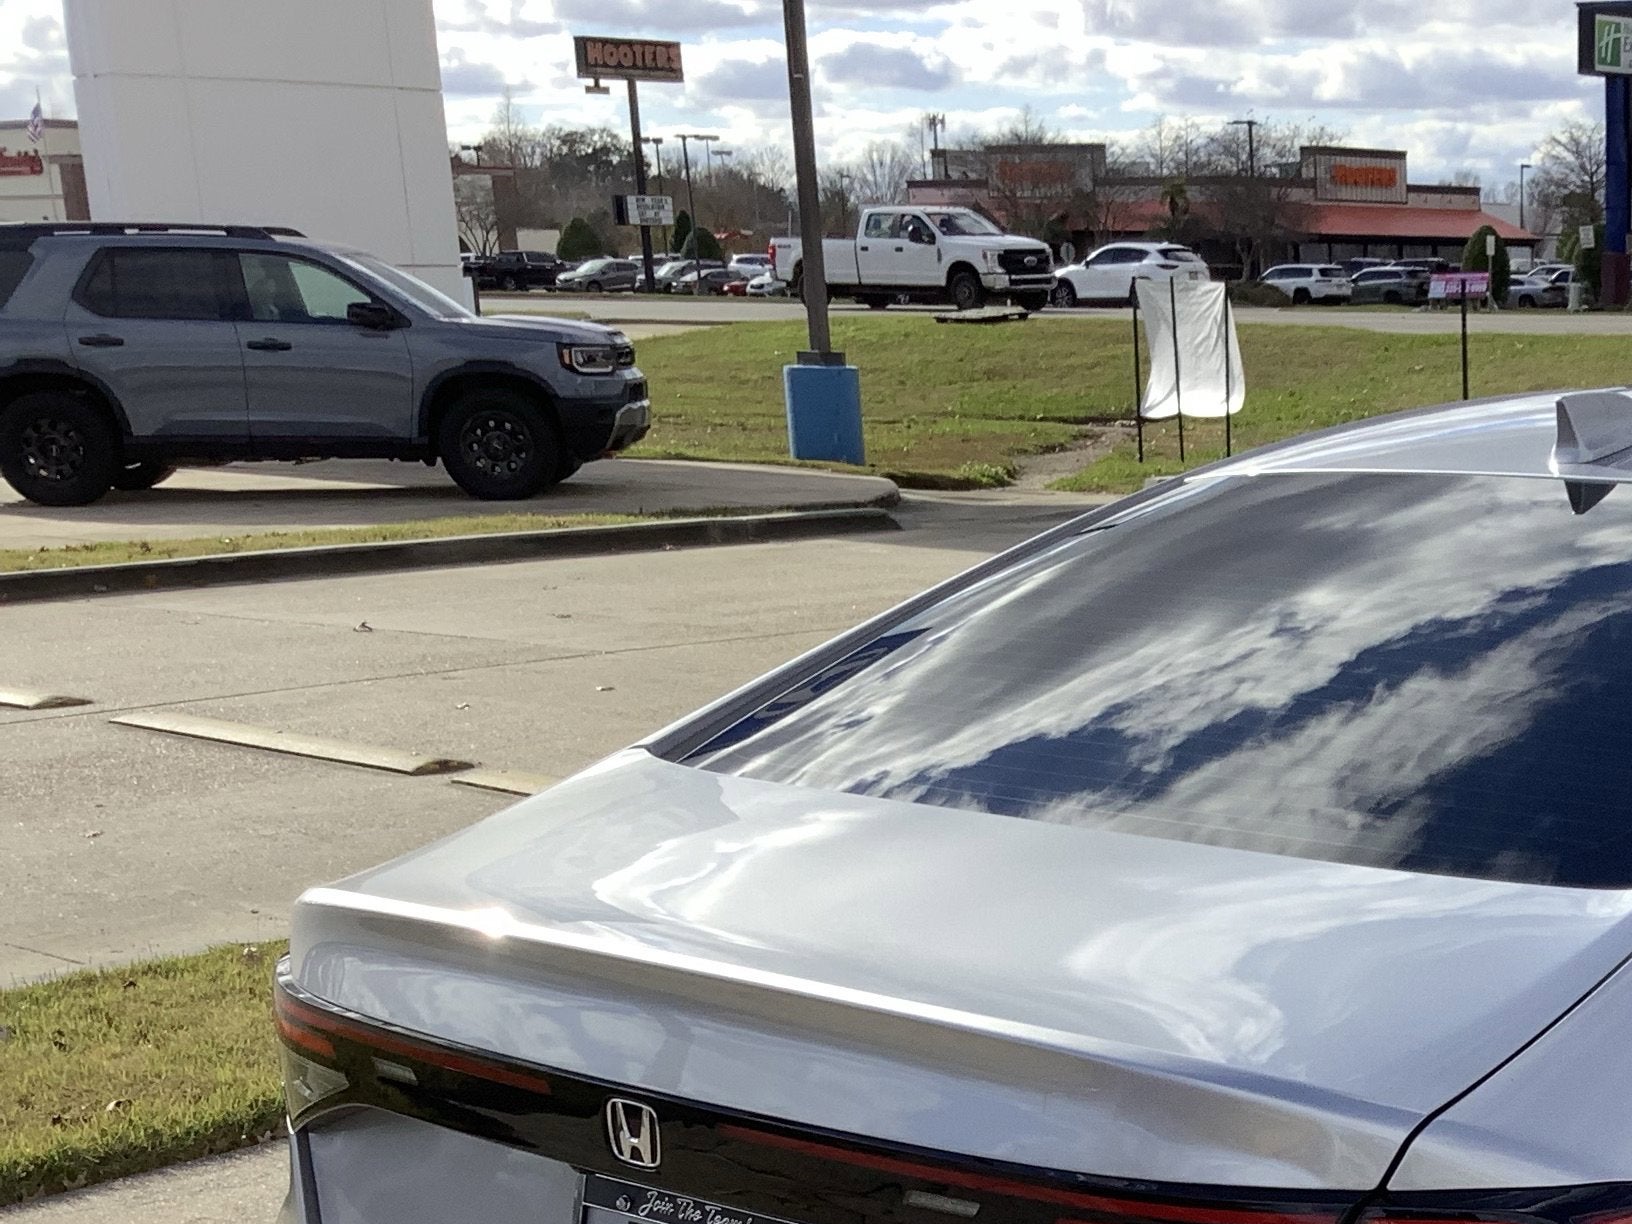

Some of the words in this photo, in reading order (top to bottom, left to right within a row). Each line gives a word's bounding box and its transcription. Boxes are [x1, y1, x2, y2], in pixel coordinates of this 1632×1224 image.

[586, 41, 682, 70] HOOTERS
[638, 1190, 675, 1216] Join
[676, 1198, 703, 1222] The
